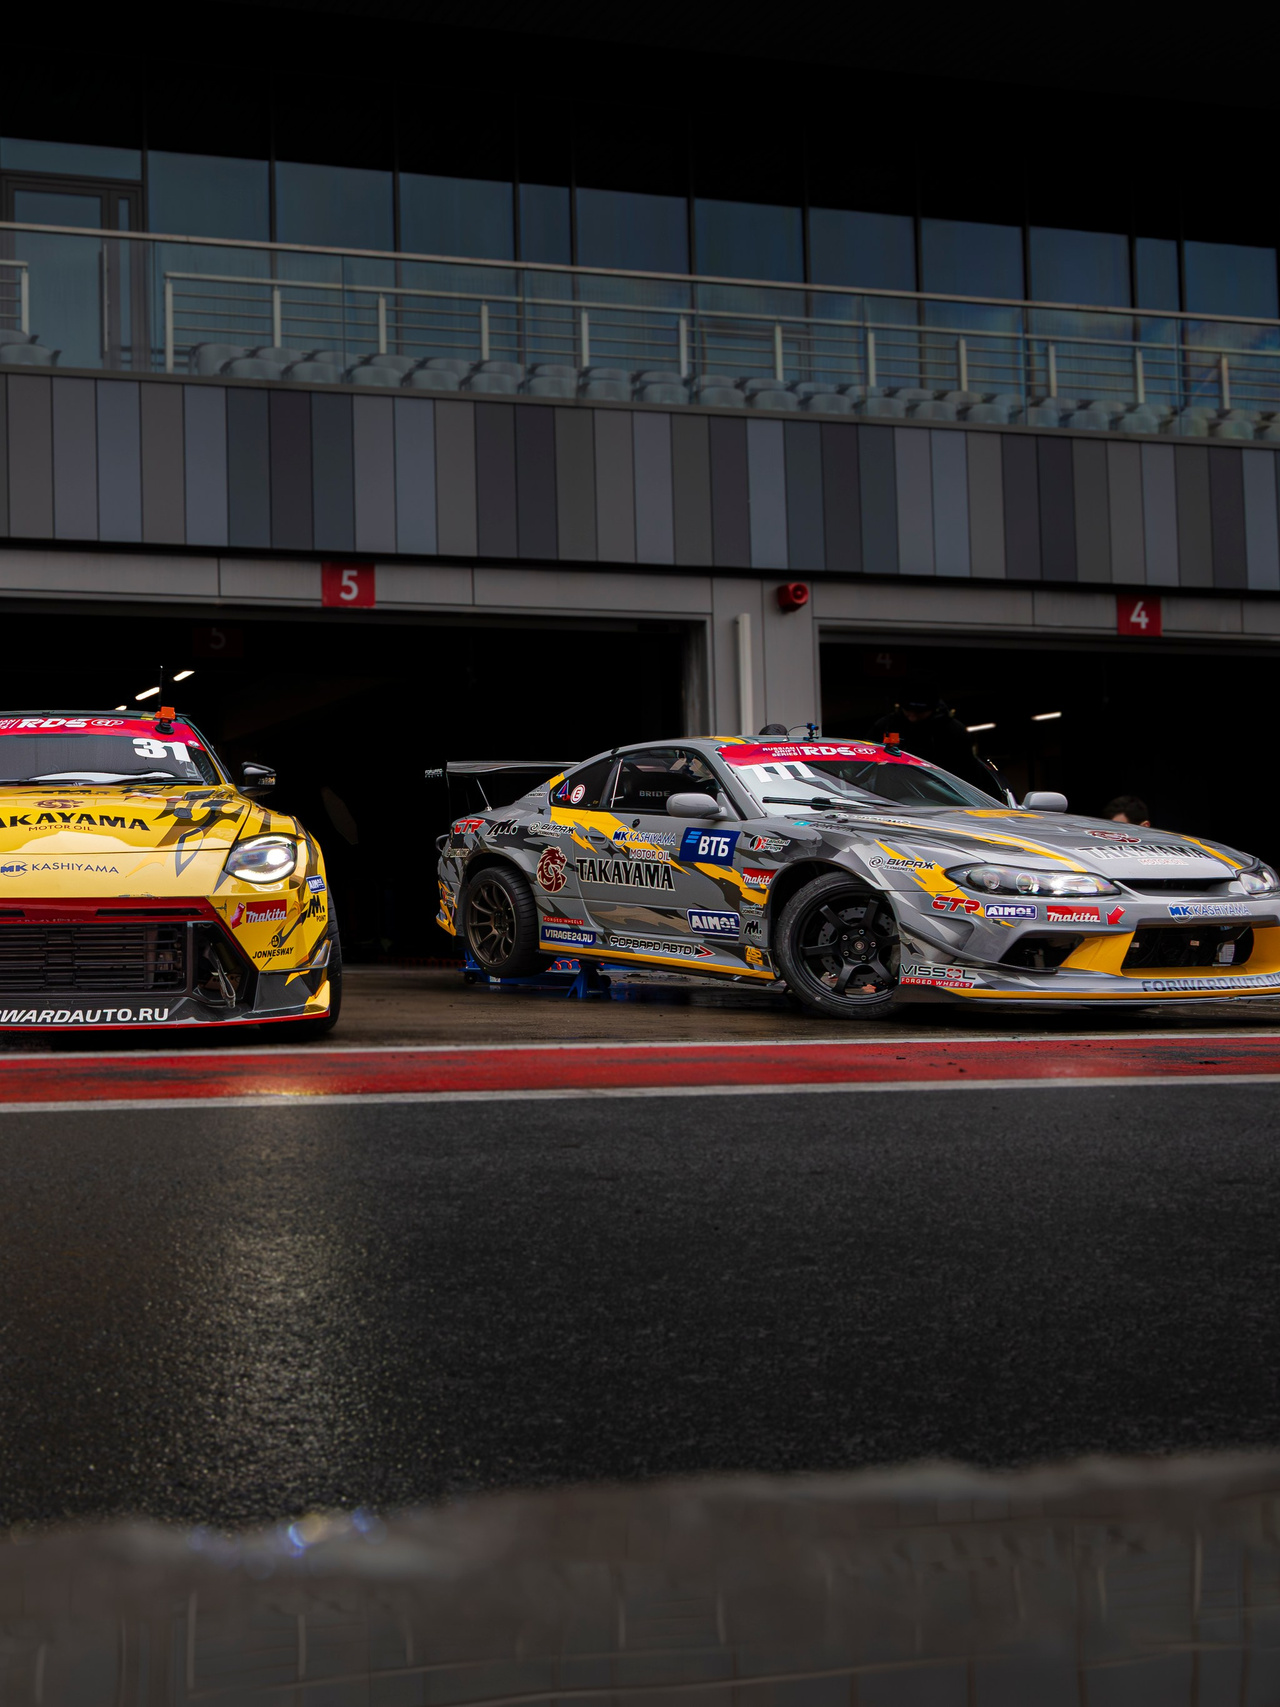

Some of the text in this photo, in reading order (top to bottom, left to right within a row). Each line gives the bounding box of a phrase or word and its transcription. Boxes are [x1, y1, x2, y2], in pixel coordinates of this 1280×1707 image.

[340, 570, 358, 600] 5
[1130, 601, 1149, 629] 4
[17, 719, 93, 728] RDS
[133, 738, 191, 762] 31
[800, 746, 857, 755] RDS
[28, 824, 70, 832] MOTOR
[540, 824, 576, 834] ВИРАЖ
[613, 831, 676, 846] MK KASHIYAMA
[698, 836, 731, 857] ВТБ
[1077, 845, 1215, 860] TAKAYAMA
[630, 849, 671, 861] MOTOR OIL
[0, 862, 120, 874] MK KASHIYAMA
[887, 858, 935, 870] ВИРАЖ
[576, 857, 675, 891] TAKAYAMA
[932, 895, 981, 914] CTR
[987, 906, 1033, 916] AIMOL
[1170, 904, 1251, 915] MK KASHIYAMA
[692, 915, 739, 931] AIMOL
[545, 929, 593, 943] VIRAGE24.RU
[610, 936, 692, 954] ФОРВАРД АВТО
[252, 947, 294, 959] JONNESWAY
[901, 964, 976, 980] VISSOL
